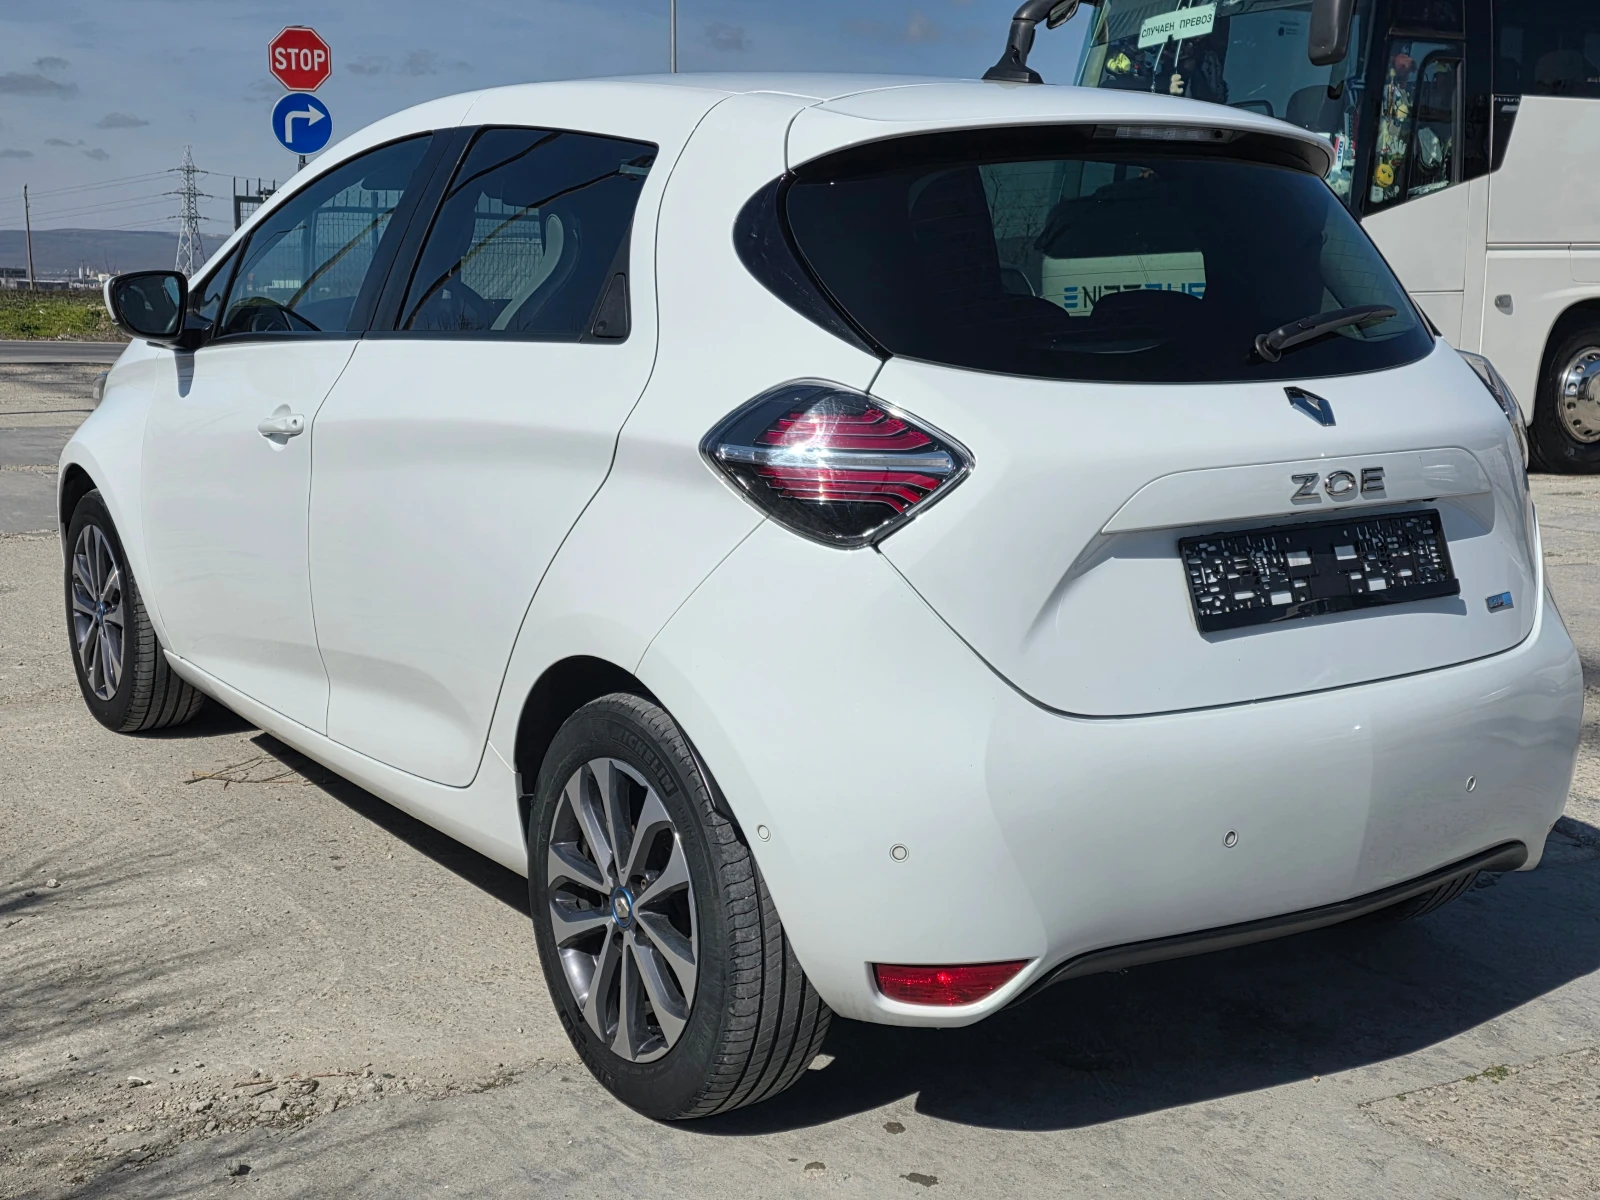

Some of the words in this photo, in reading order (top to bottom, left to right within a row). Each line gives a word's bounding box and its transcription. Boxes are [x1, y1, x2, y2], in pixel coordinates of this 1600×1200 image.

[1141, 22, 1175, 38] СЛУЧАЕН
[1180, 14, 1213, 29] ПРЕВОЗ
[274, 47, 326, 71] STOP
[1289, 466, 1386, 503] ZOE
[612, 728, 675, 794] MICHELIN
